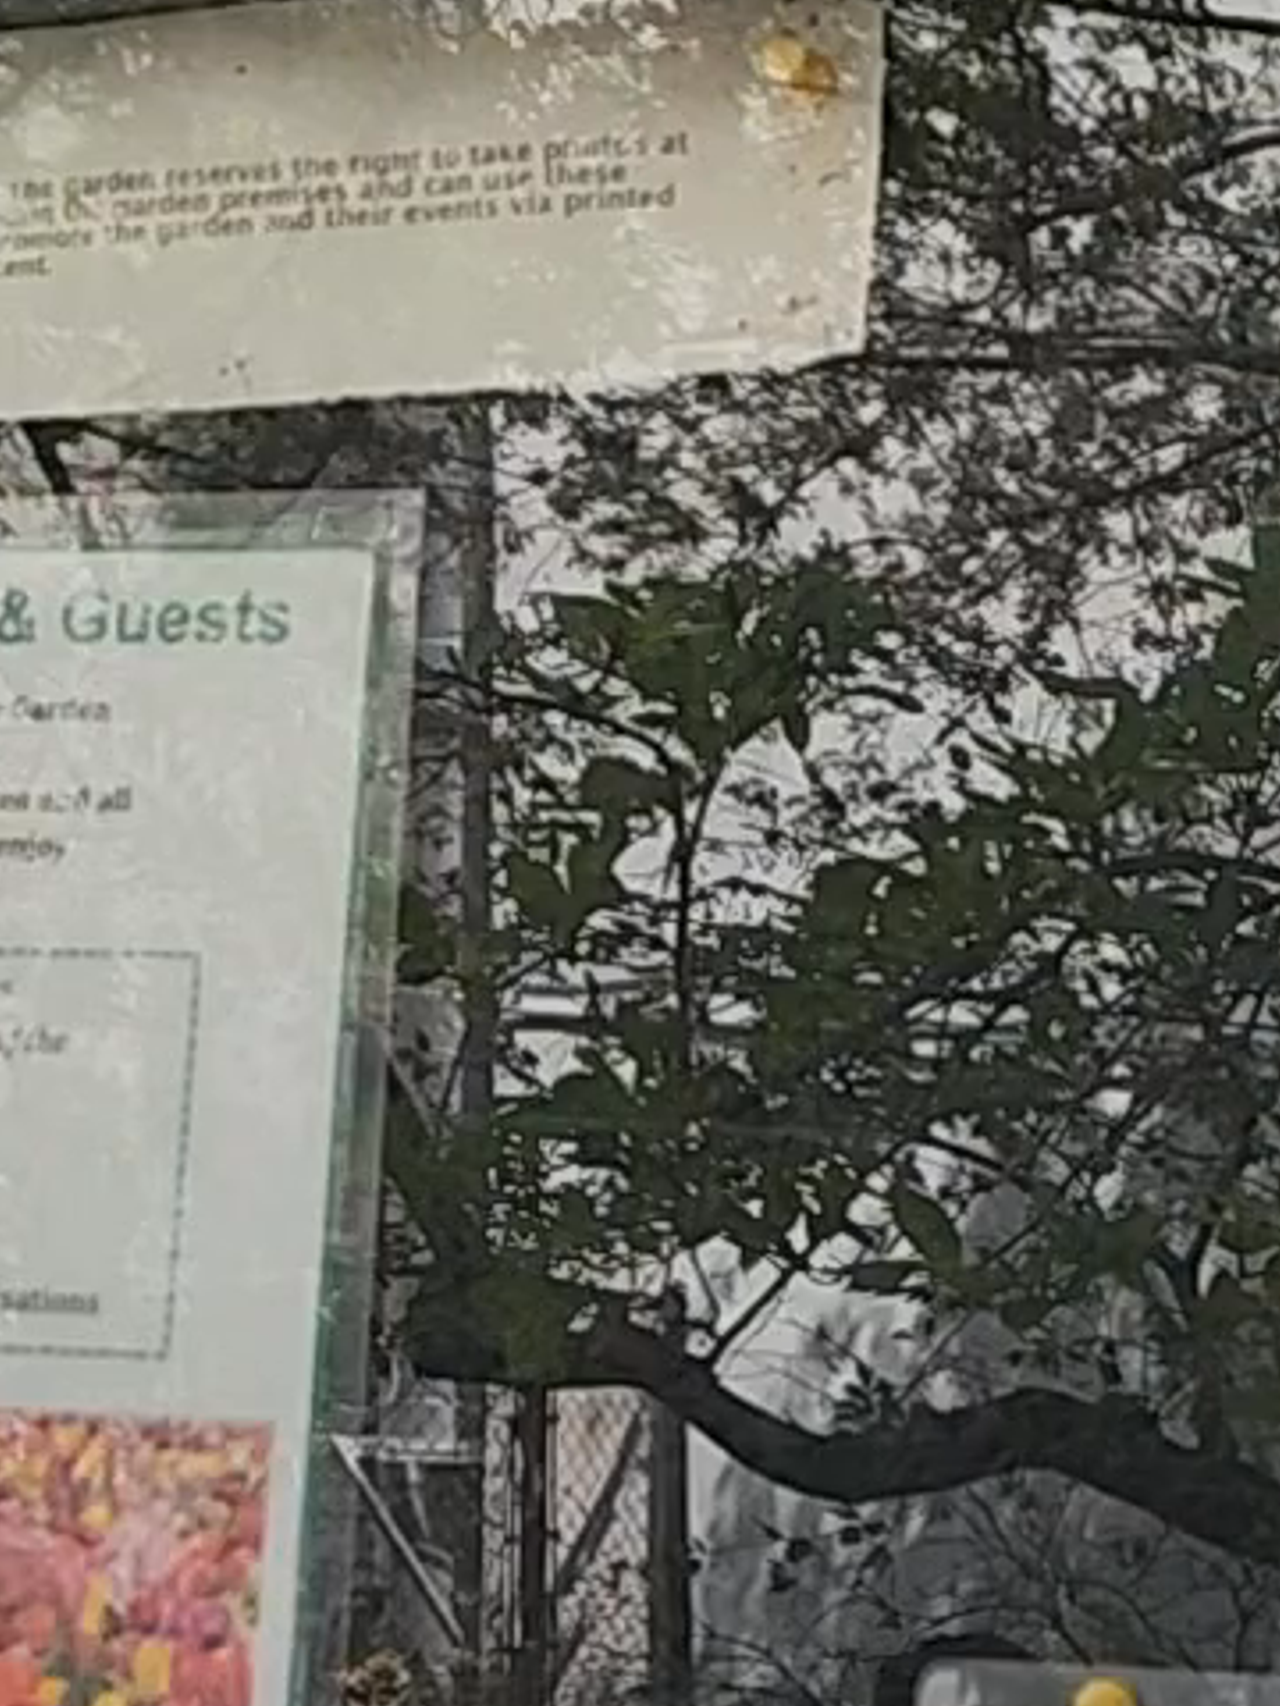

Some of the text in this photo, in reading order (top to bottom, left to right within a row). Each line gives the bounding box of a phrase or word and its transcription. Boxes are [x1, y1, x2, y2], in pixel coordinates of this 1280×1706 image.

[166, 158, 281, 189] reserves
[292, 154, 339, 180] the
[349, 149, 420, 181] right
[431, 148, 461, 170] to
[469, 141, 532, 167] take
[659, 131, 689, 156] at
[221, 182, 348, 215] premises
[359, 174, 413, 201] and
[423, 172, 473, 197] can
[481, 169, 534, 192] use
[545, 158, 627, 186] these
[156, 215, 255, 248] garden
[264, 208, 315, 234] and
[324, 201, 393, 229] their
[401, 195, 499, 225] events
[509, 190, 553, 215] via
[563, 182, 677, 218] printed
[60, 587, 293, 648] Guests
